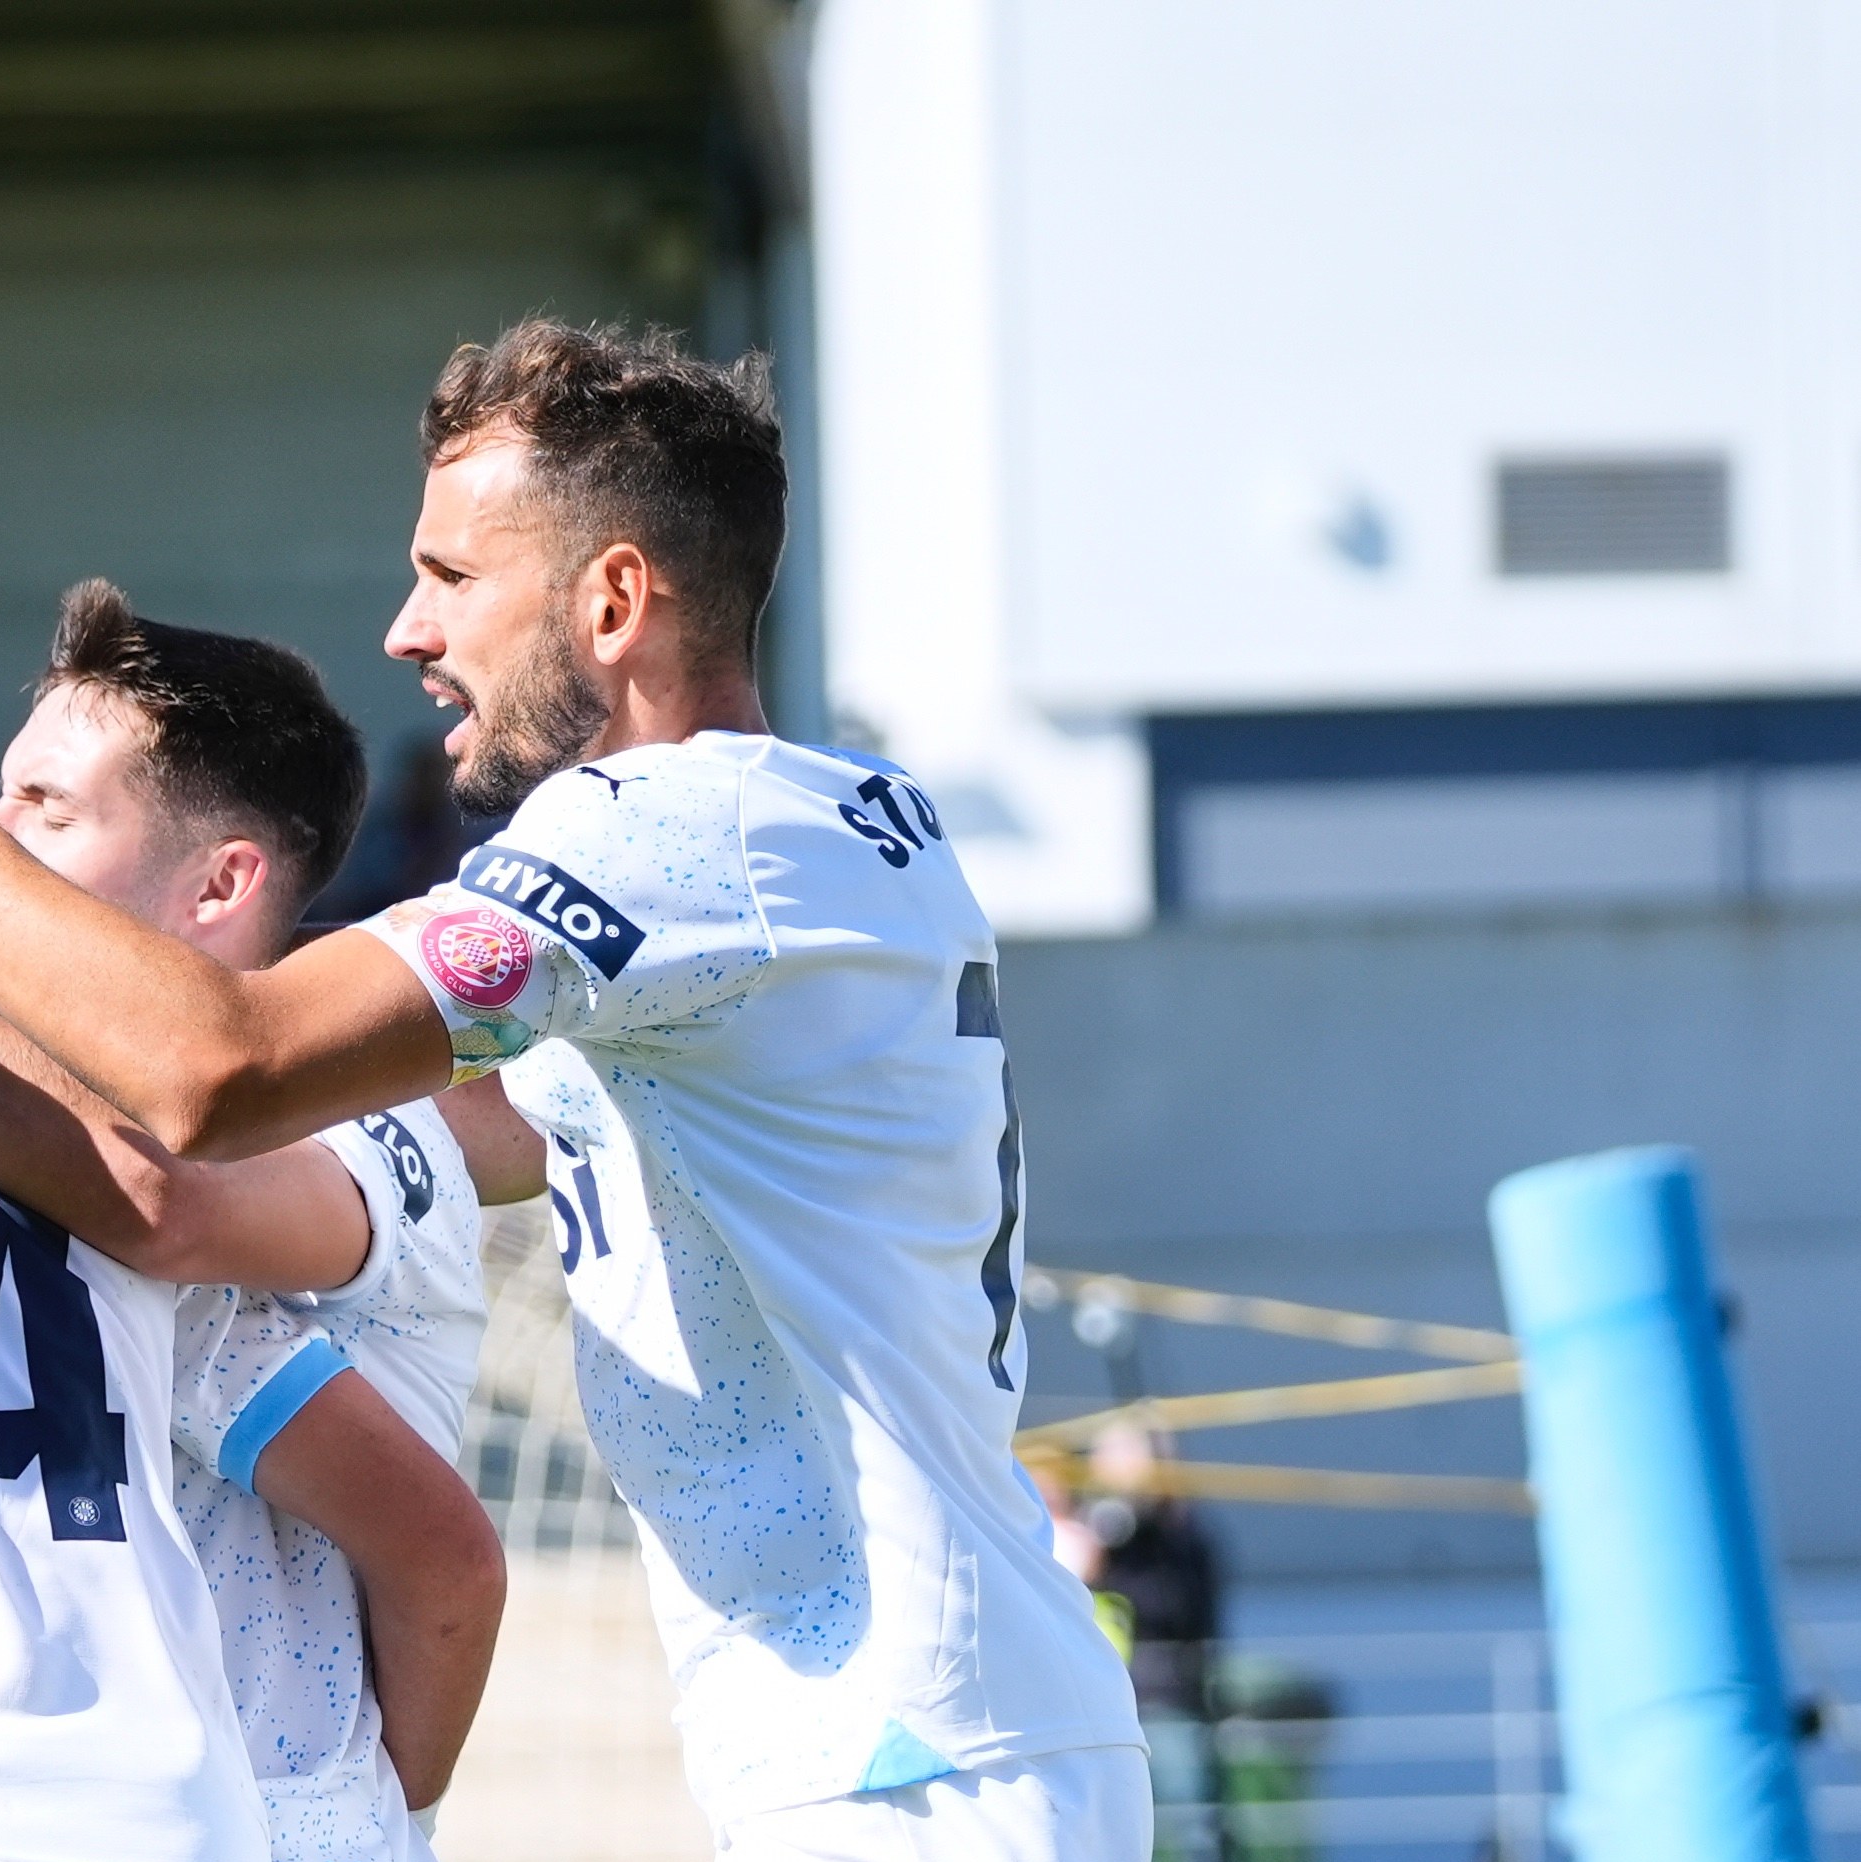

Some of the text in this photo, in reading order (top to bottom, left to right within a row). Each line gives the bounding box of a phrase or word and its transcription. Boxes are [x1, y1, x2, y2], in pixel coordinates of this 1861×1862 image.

[474, 856, 602, 941] HYLO
[425, 938, 474, 997] FUTBOL CLUB
[477, 911, 527, 972] GIRONA
